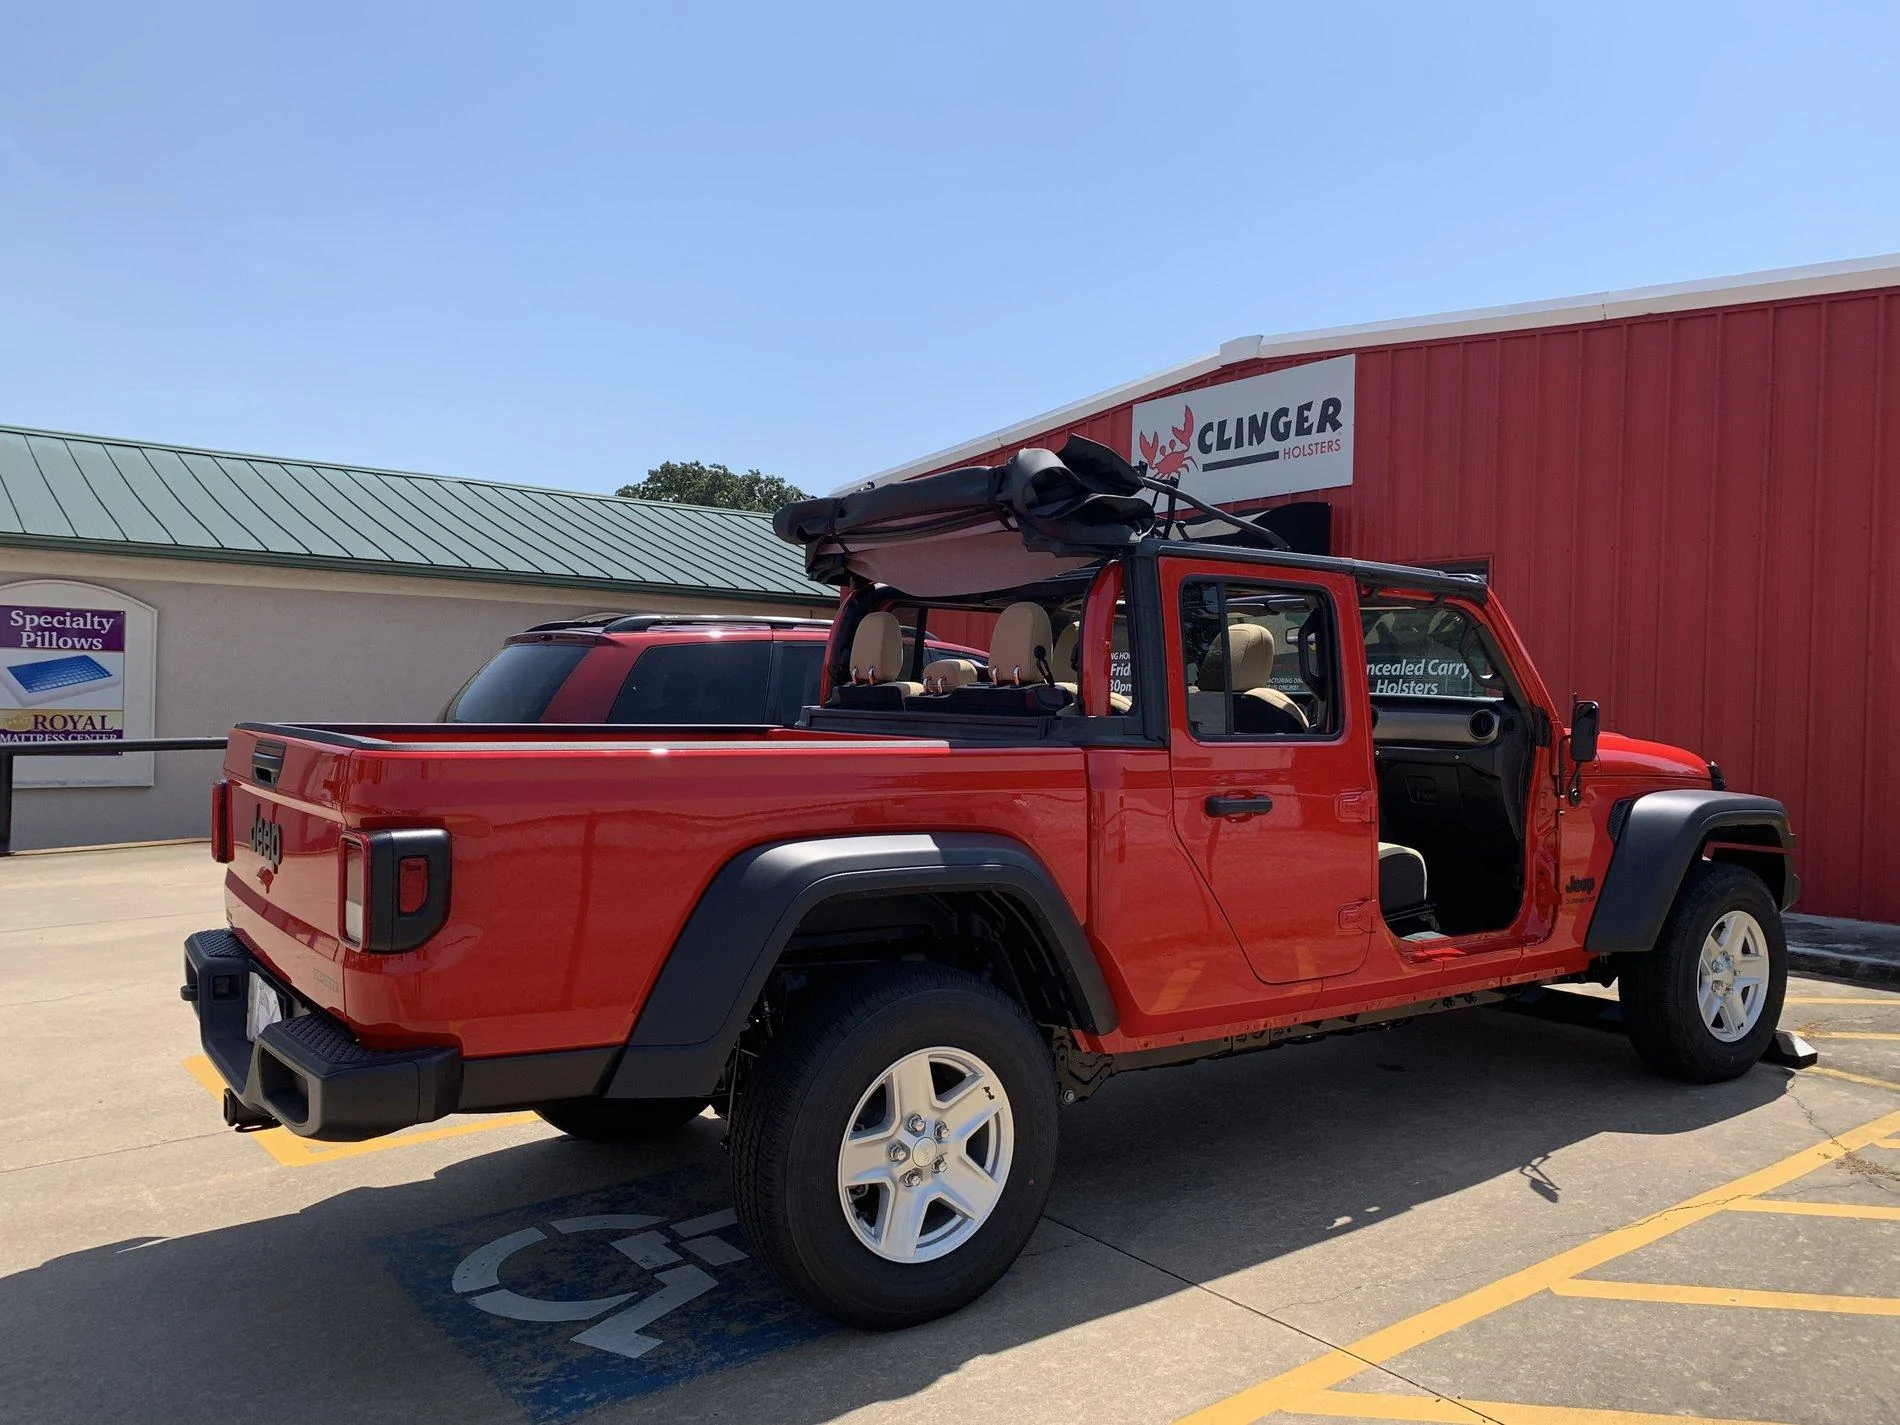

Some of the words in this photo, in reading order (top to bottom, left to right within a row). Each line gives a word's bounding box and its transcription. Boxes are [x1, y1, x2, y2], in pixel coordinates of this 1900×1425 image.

[1197, 397, 1343, 455] CLINGER
[1283, 438, 1341, 460] HOLSTERS
[10, 610, 114, 633] Specialty
[20, 632, 103, 650] Pillows
[1110, 663, 1131, 676] Frid
[1428, 659, 1469, 679] Carry
[1376, 679, 1439, 695] Holsters
[33, 714, 114, 731] ROYAL
[0, 734, 65, 743] MATTRESS
[250, 803, 283, 874] Jeep
[1565, 874, 1596, 894] Jeep
